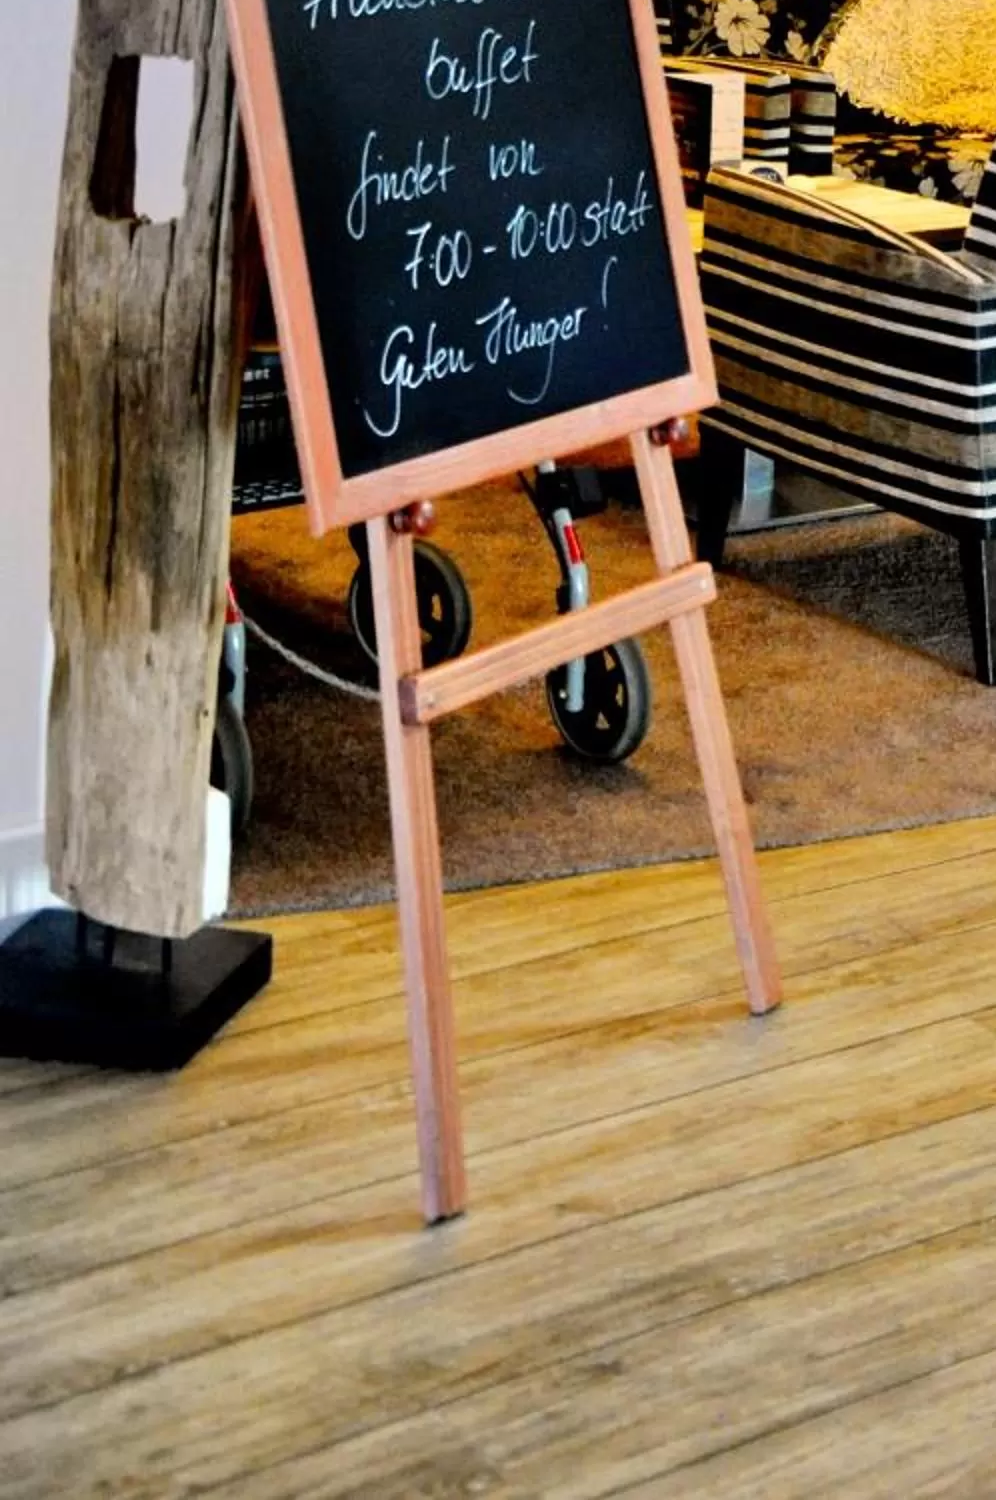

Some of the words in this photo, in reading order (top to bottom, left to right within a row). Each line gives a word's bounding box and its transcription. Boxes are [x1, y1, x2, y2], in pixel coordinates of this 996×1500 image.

[425, 20, 539, 119] buffet
[347, 130, 456, 240] findet
[489, 140, 544, 181] von
[581, 170, 653, 248] statt
[363, 322, 475, 438] Guten
